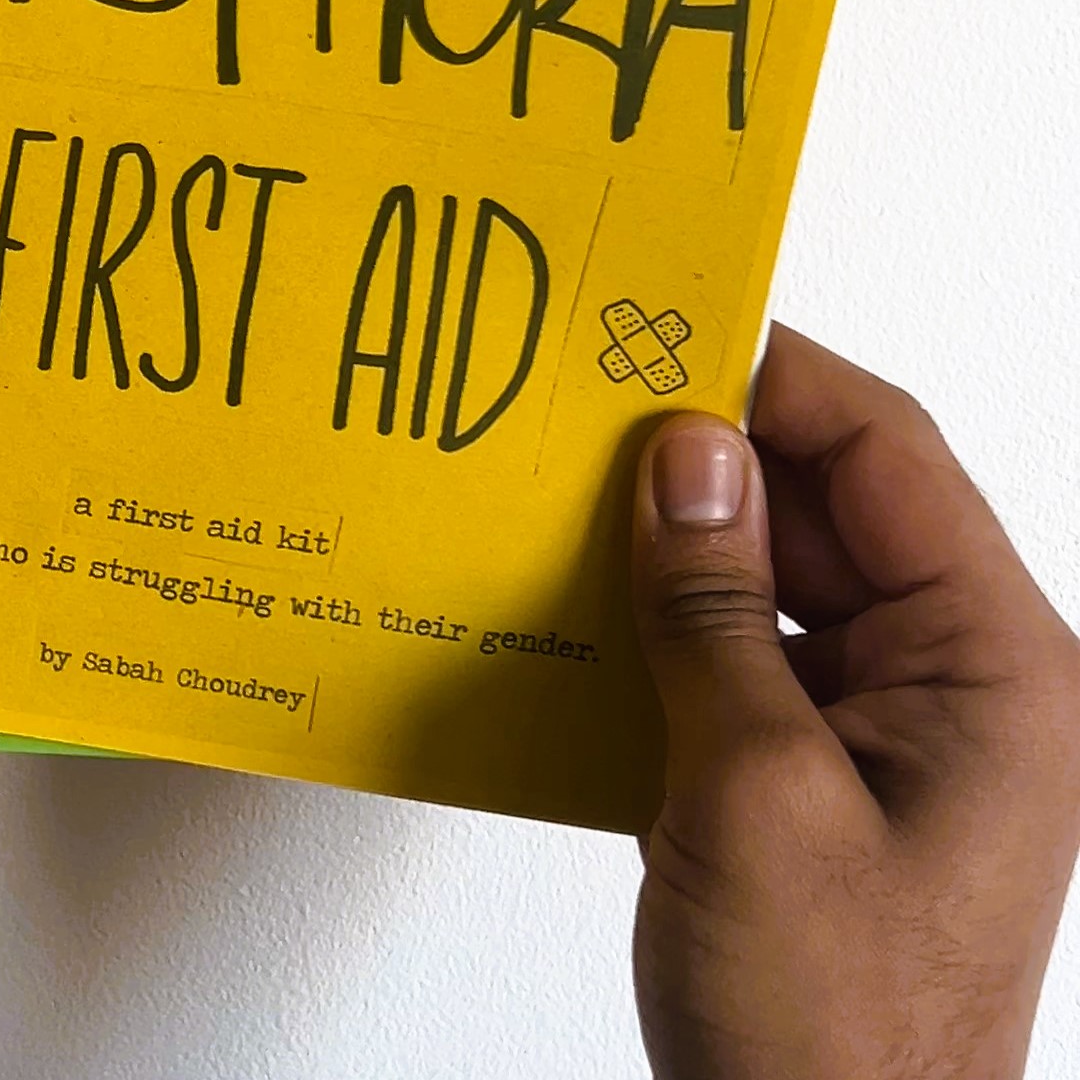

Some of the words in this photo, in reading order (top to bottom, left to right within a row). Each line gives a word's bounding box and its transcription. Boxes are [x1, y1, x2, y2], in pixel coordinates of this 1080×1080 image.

[333, 185, 549, 452] AID
[73, 497, 93, 517] a
[108, 498, 195, 532] first
[206, 518, 263, 545] aid
[276, 525, 331, 556] kit
[41, 548, 76, 574] is
[88, 558, 277, 618] struggling
[290, 597, 362, 628] with
[377, 606, 468, 642] their
[479, 628, 600, 663] gender.
[40, 641, 73, 672] by
[82, 651, 164, 684] Sabah
[177, 668, 308, 713] Choudrey
